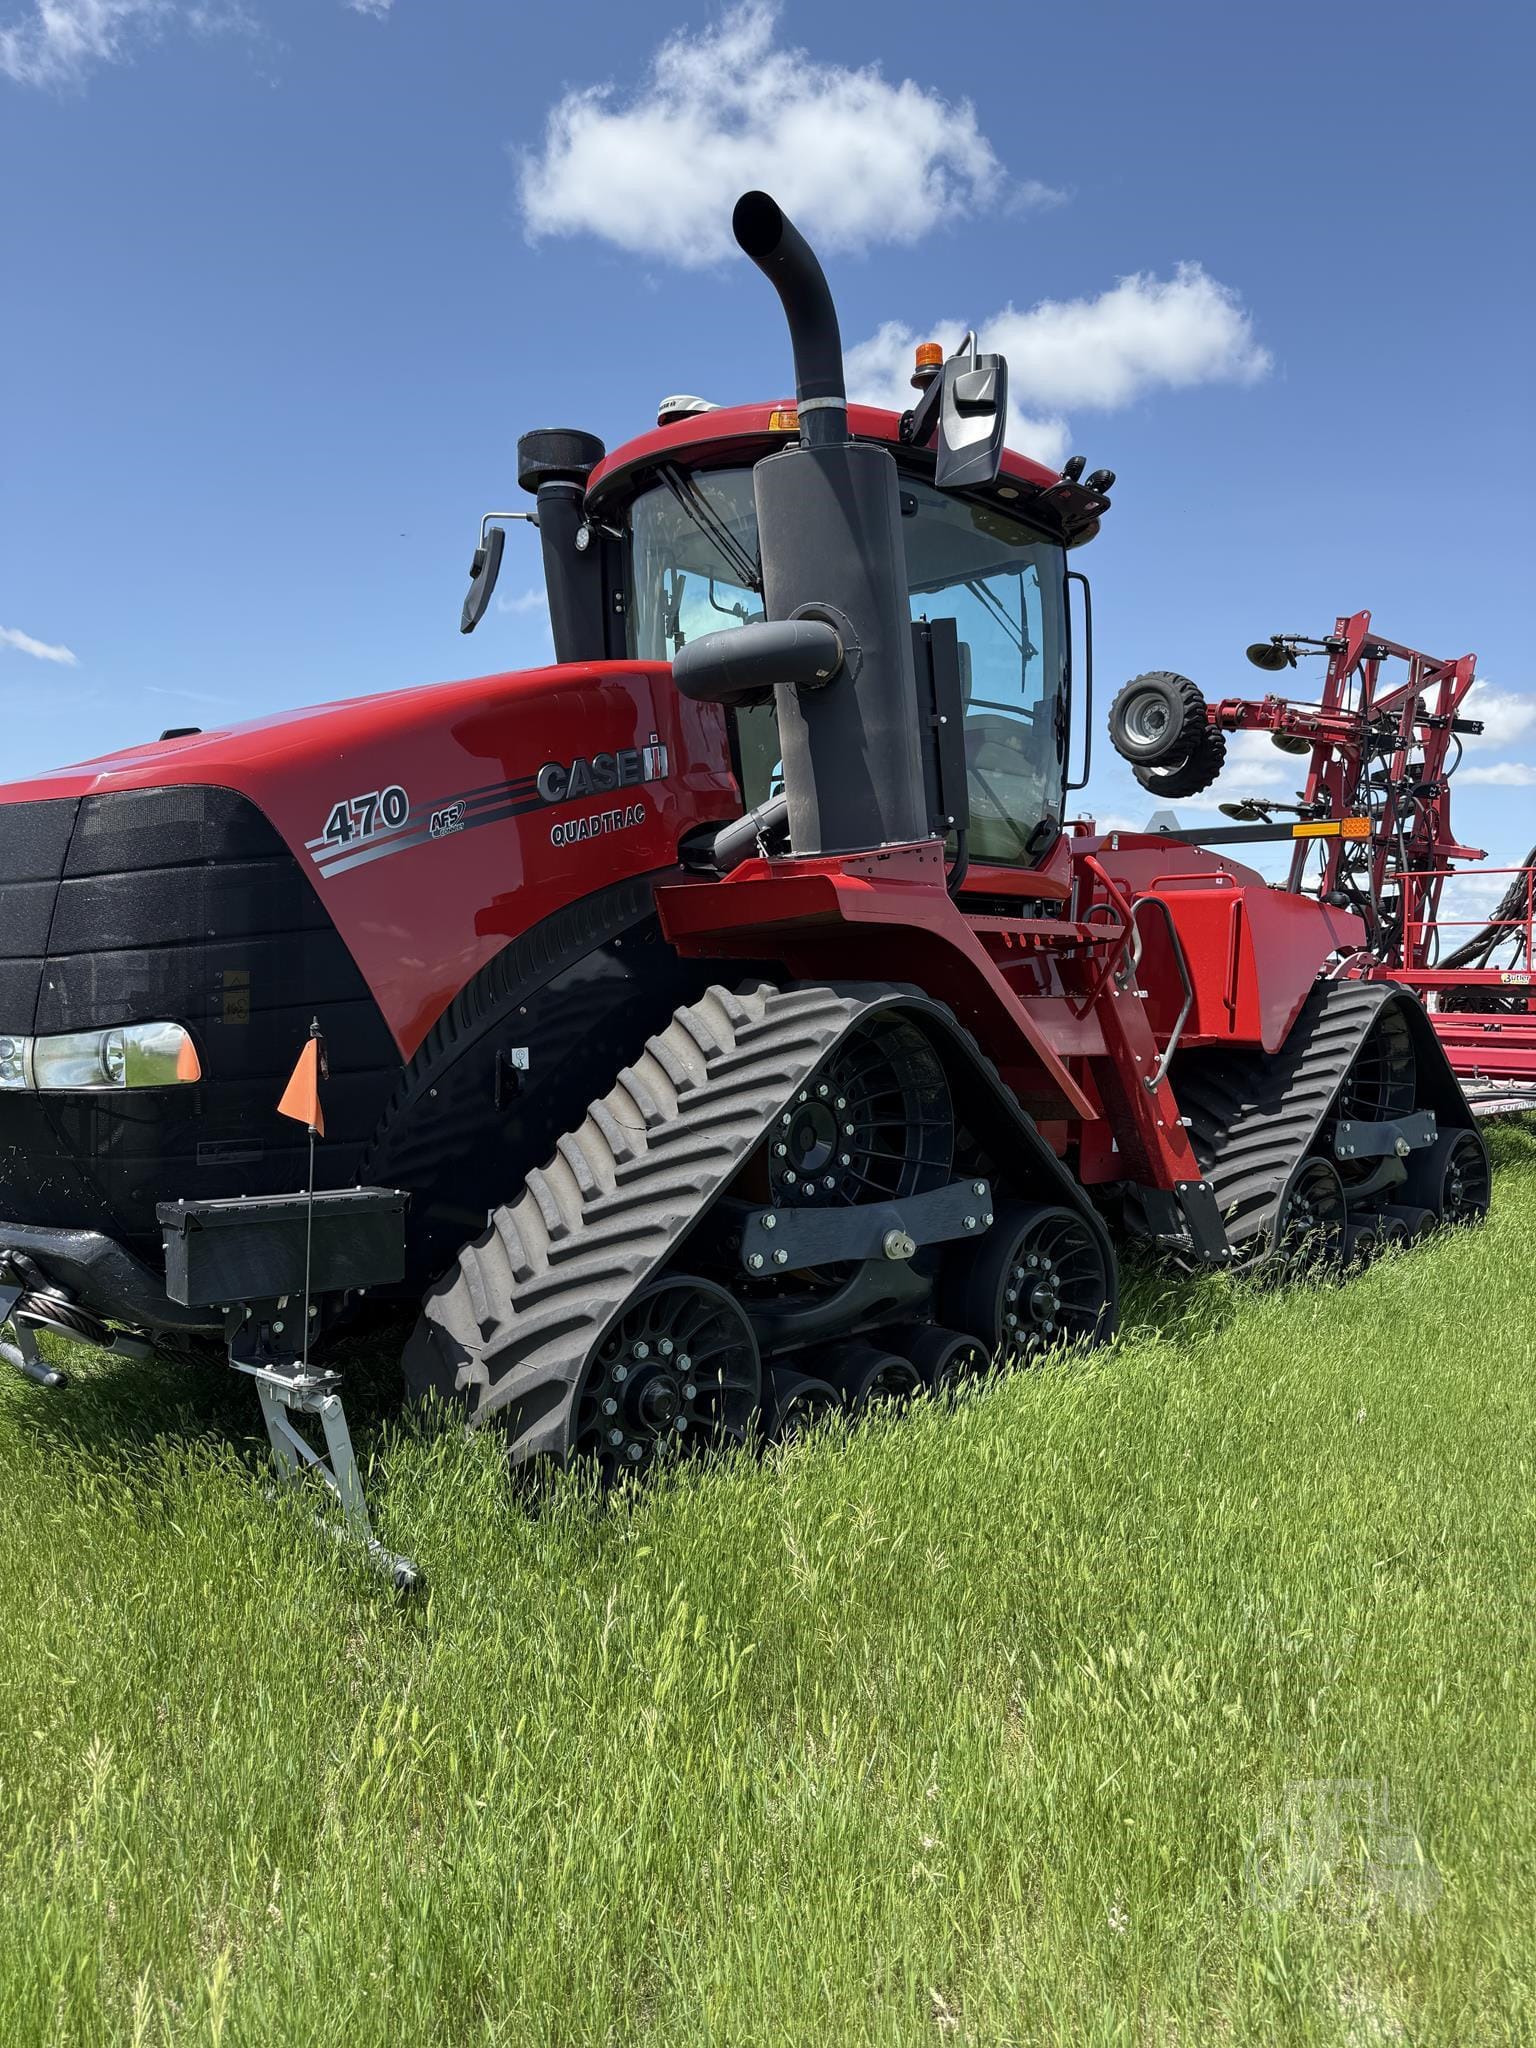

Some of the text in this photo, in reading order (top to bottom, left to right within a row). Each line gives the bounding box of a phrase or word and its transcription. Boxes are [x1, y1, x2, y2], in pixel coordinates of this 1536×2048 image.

[1376, 645, 1385, 657] 24
[1394, 737, 1403, 748] 26
[537, 750, 641, 803] CASE
[322, 784, 410, 847] 470
[429, 805, 460, 833] AFS
[550, 803, 646, 847] QUADTRAC
